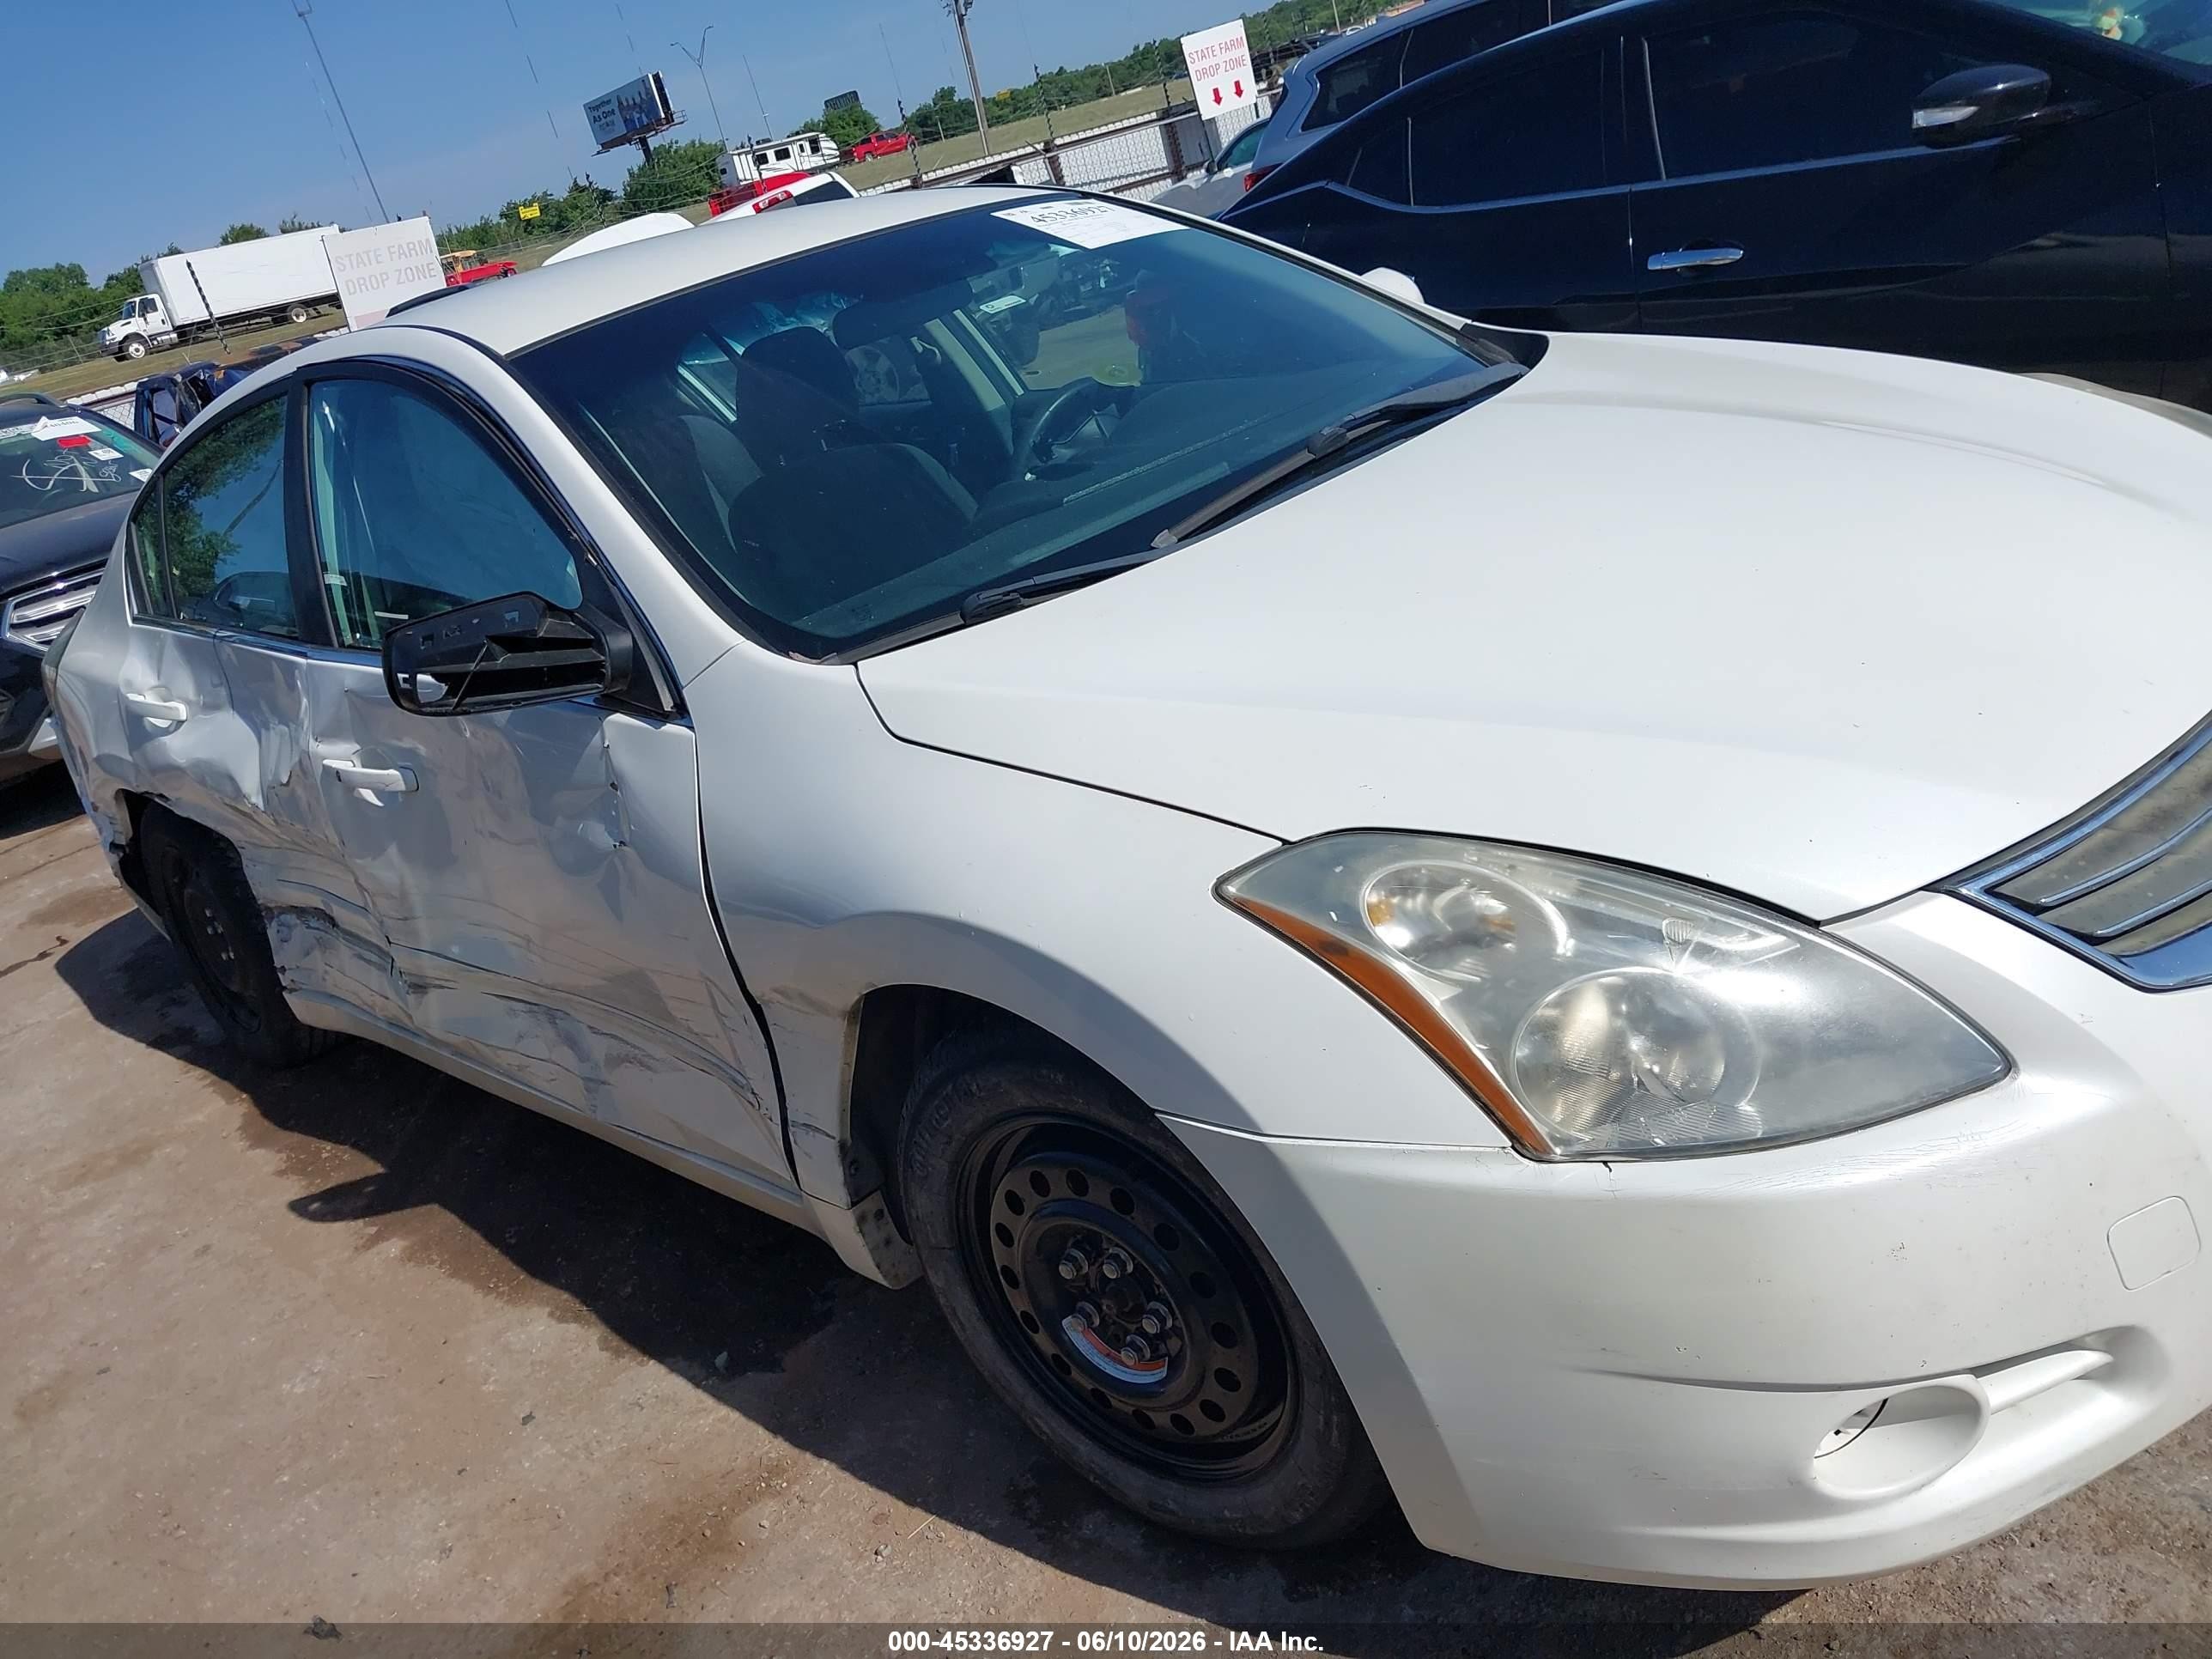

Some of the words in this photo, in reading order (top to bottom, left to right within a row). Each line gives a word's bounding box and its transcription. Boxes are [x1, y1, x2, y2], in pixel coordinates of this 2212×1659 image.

[1188, 46, 1217, 64] STATE
[1218, 36, 1245, 55] FARM
[1194, 64, 1221, 82] DROP
[1223, 54, 1247, 73] ZONE
[592, 114, 602, 124] As
[602, 108, 616, 119] One
[335, 247, 383, 272] STATE
[387, 239, 434, 262] FARM
[345, 270, 390, 296] DROP
[393, 262, 437, 285] ZONE
